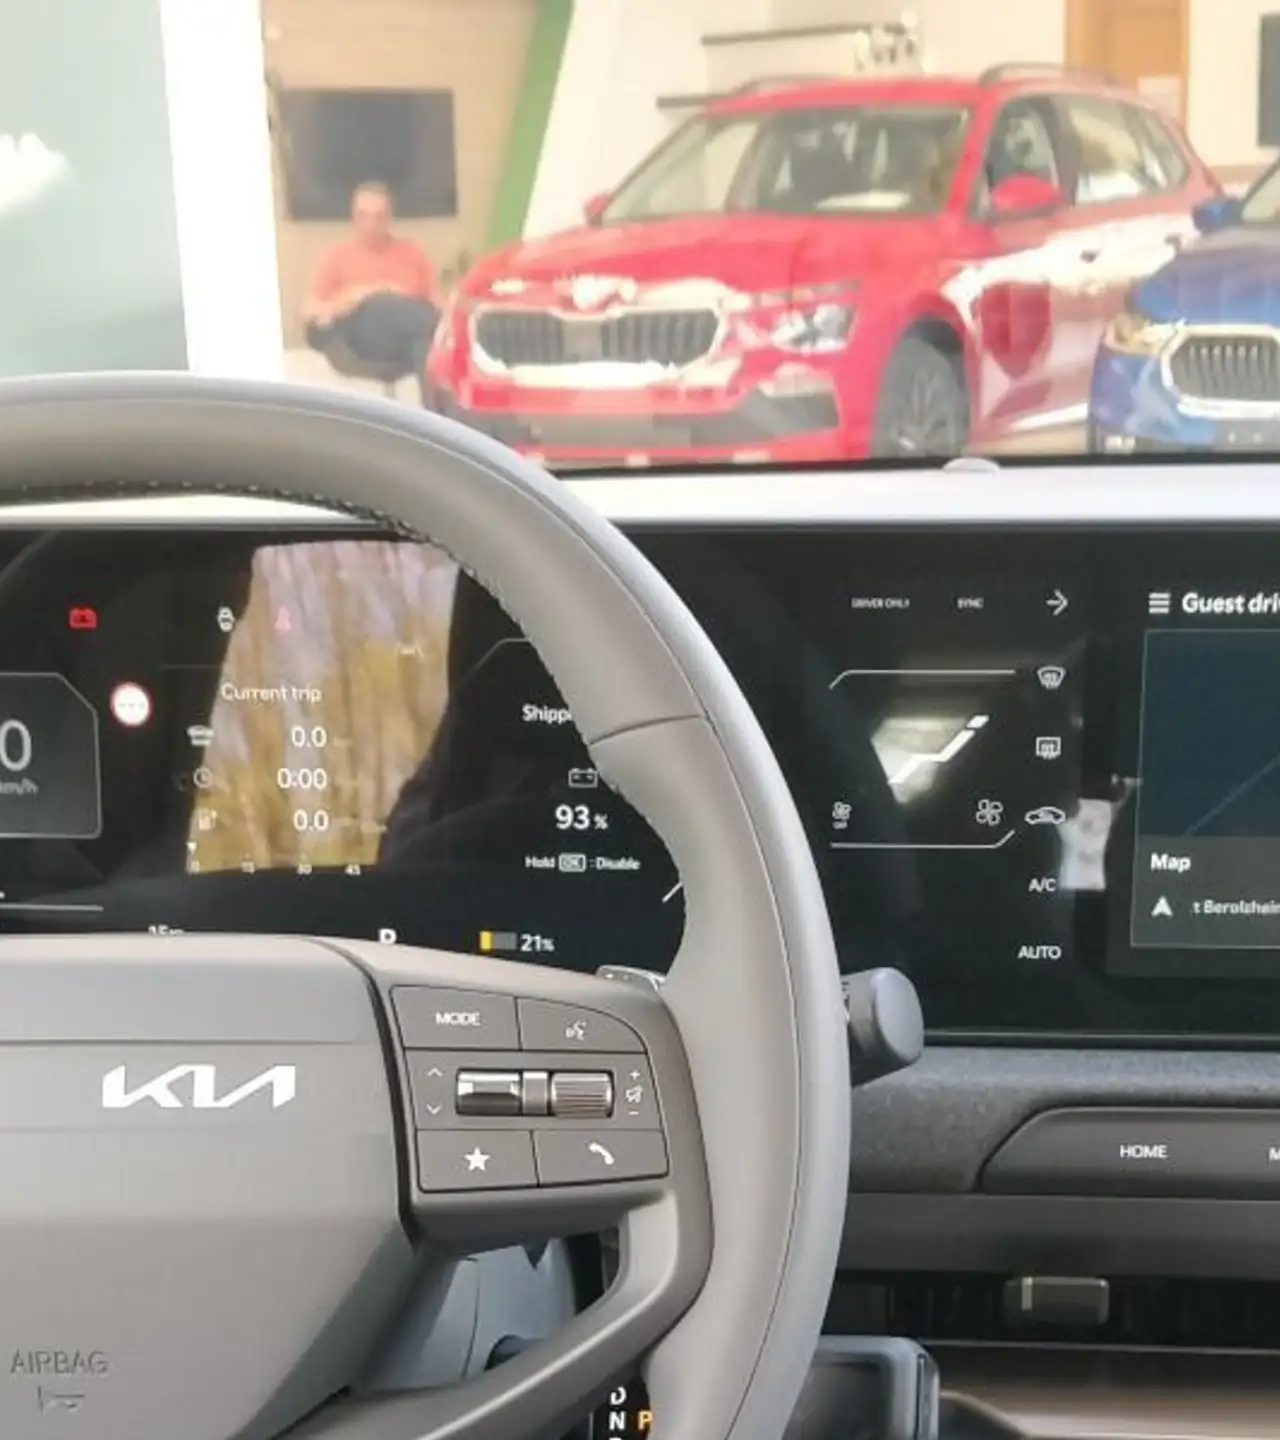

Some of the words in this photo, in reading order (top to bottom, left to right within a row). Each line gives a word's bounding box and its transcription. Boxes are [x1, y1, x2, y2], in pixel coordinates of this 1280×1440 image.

[1182, 592, 1245, 614] Guest
[221, 682, 286, 701] Current
[290, 683, 322, 703] trip
[291, 726, 327, 748] 0.0
[276, 767, 327, 789] 0:00
[293, 810, 329, 831] 0.0
[555, 804, 590, 830] 93
[1151, 854, 1191, 873] Map
[1028, 878, 1056, 892] A/C
[520, 934, 554, 951] 21%
[1018, 946, 1061, 959] AUTO
[436, 1012, 481, 1026] MODE
[102, 1065, 296, 1108] KIA
[1120, 1144, 1167, 1159] HOME
[10, 1348, 109, 1375] AIRBAG
[609, 1411, 626, 1430] N
